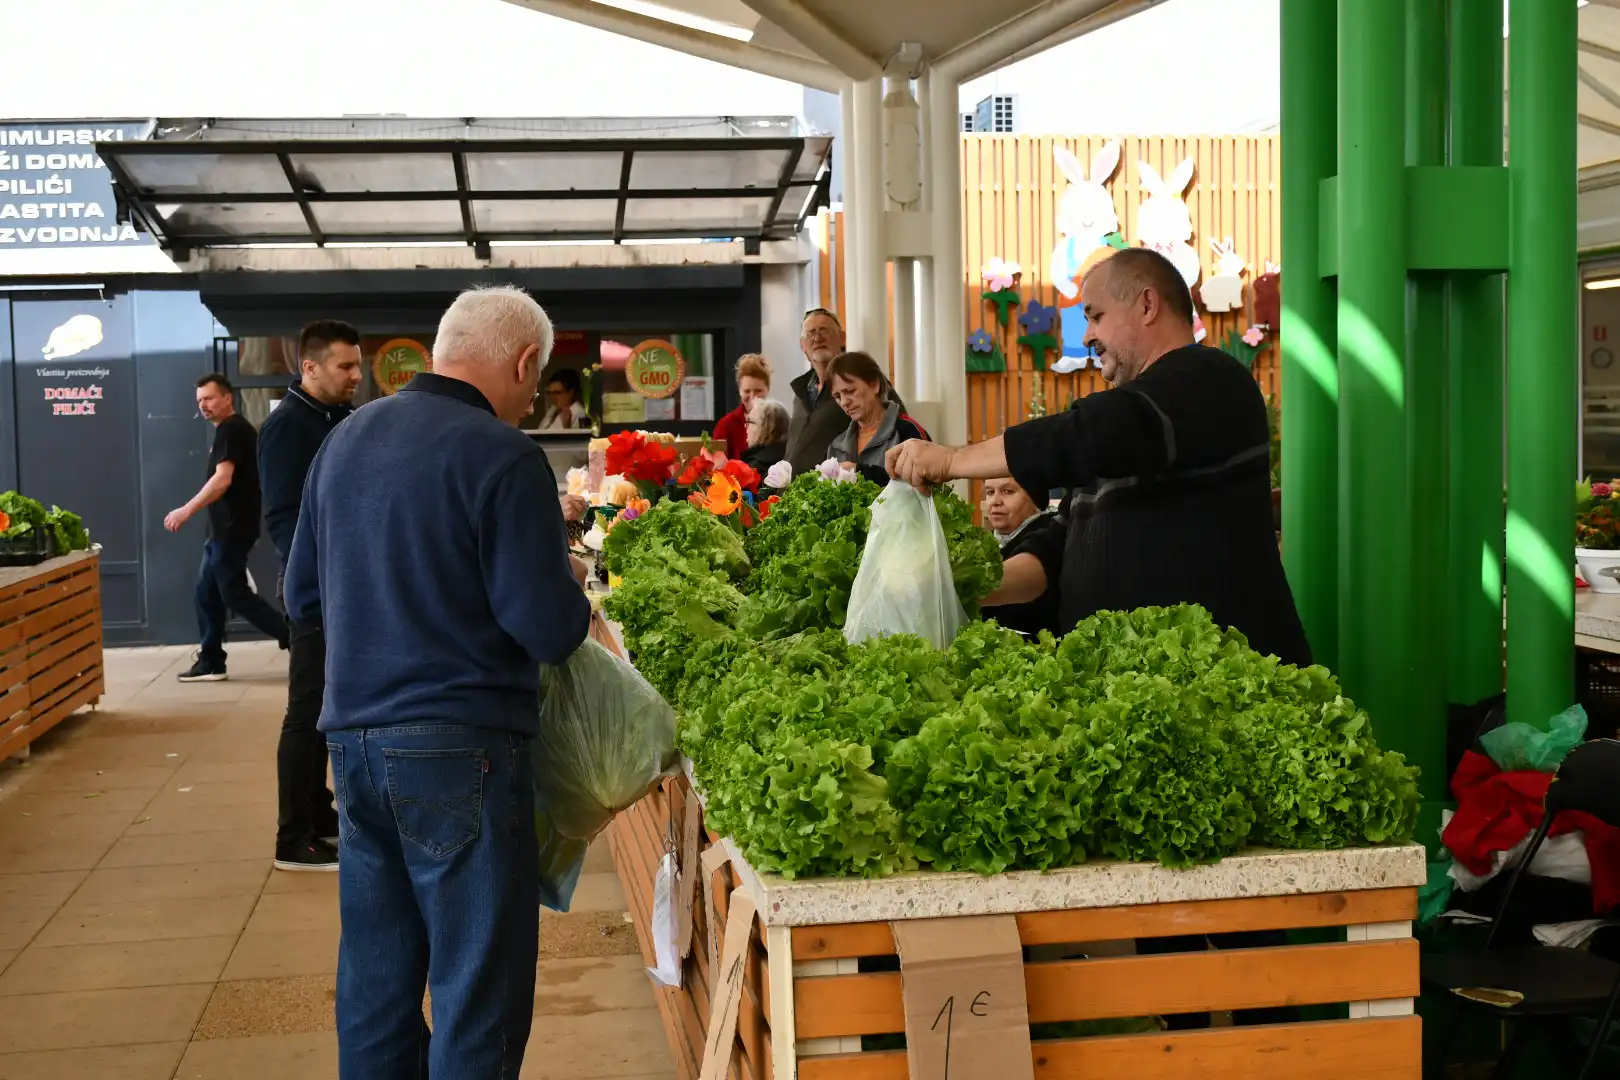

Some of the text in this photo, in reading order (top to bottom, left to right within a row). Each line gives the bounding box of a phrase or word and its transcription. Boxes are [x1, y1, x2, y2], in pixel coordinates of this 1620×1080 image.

[0, 129, 123, 145] IMURSKI
[0, 174, 72, 194] PILIĆI
[385, 348, 407, 365] NE
[638, 349, 660, 366] NE
[36, 366, 110, 379] Vlastita proizvodnja
[640, 371, 670, 386] GMO
[44, 384, 103, 400] DOMAĆI
[52, 400, 96, 416] PILIĆI
[930, 990, 991, 1080] 1 €
